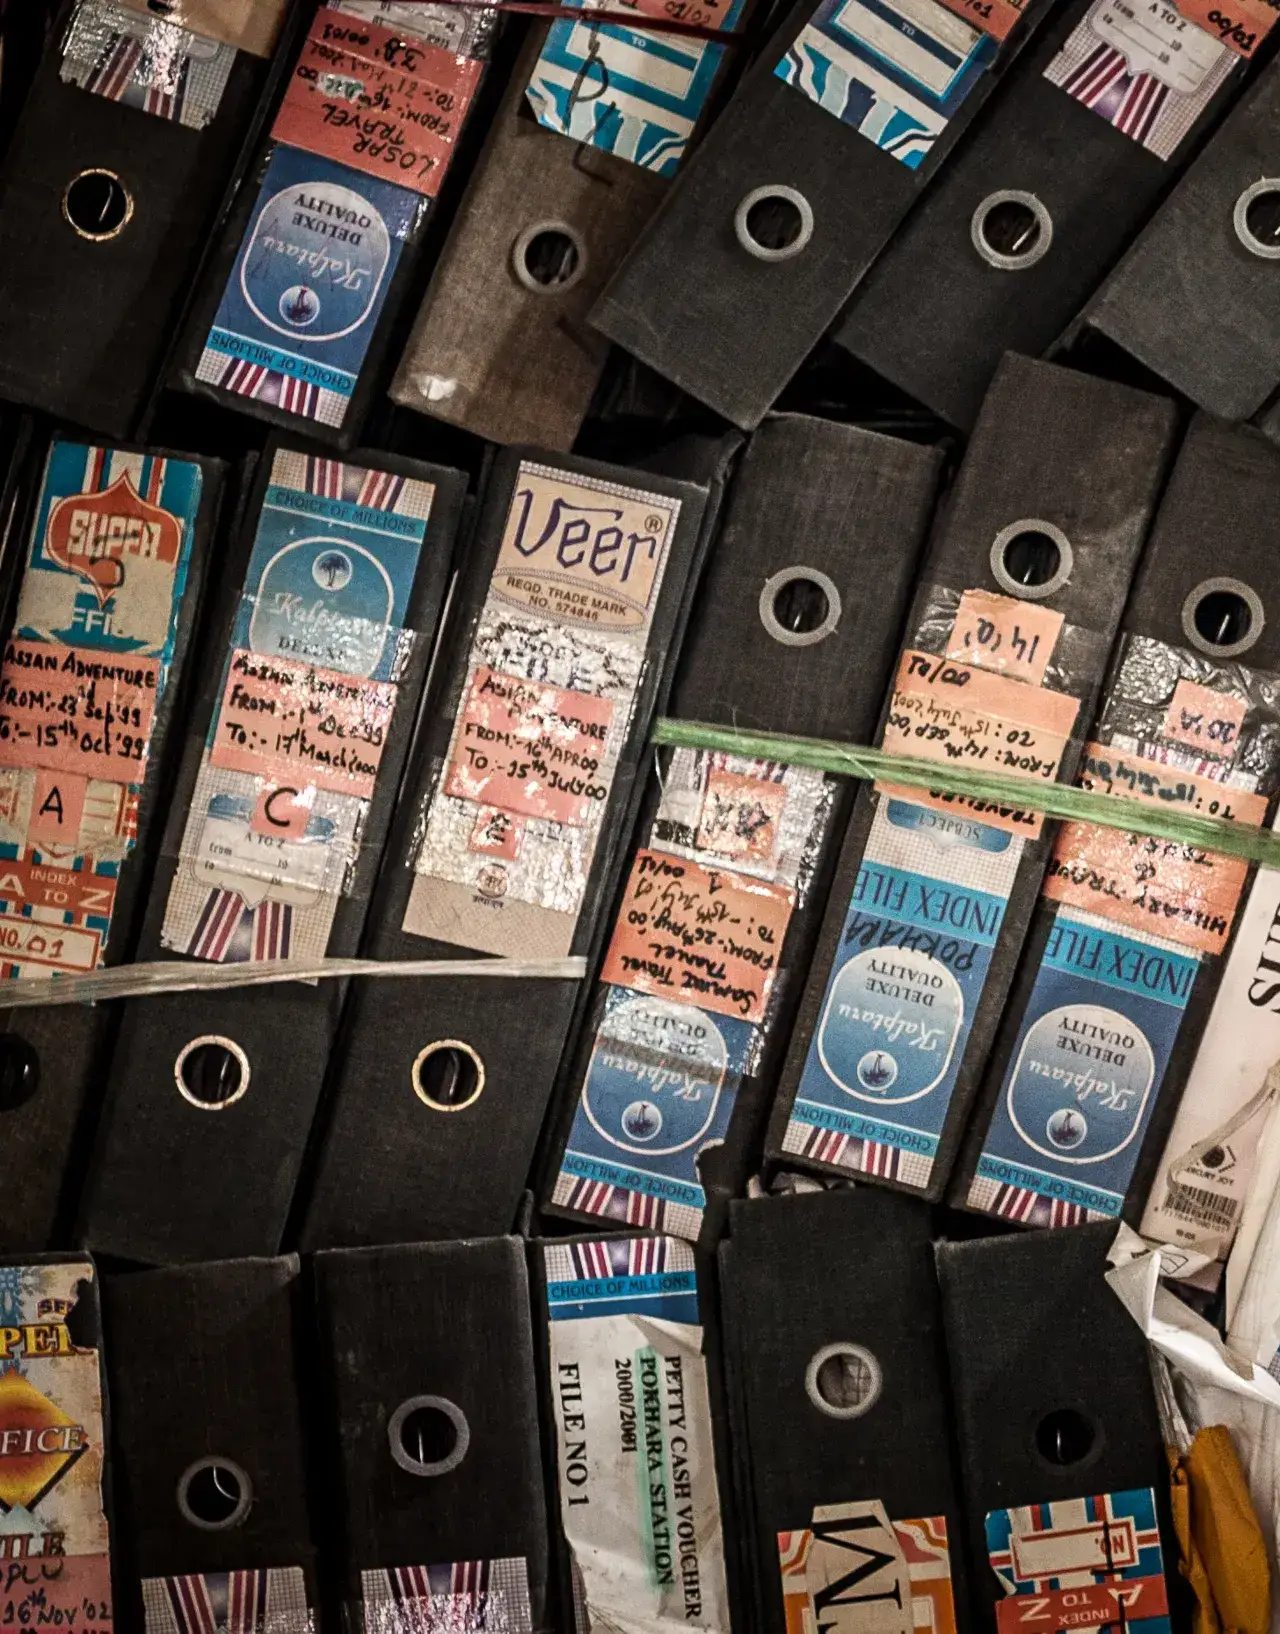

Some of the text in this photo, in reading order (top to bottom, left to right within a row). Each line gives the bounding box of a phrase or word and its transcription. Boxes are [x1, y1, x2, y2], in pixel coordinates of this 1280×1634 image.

[322, 103, 405, 146] TRAVEL
[291, 211, 362, 246] DELUXE
[293, 193, 372, 229] QUALITY
[263, 236, 372, 291] Kalptaru
[211, 332, 351, 390] CHOICE OF MILLIONS
[513, 487, 657, 584] Veer
[505, 576, 628, 616] REGD. TRADE MARK
[61, 651, 156, 689] ADVENTURE
[39, 785, 64, 824] A
[263, 787, 300, 828] C
[0, 873, 110, 912] A TO Z
[30, 869, 77, 888] INDEX
[852, 868, 1001, 938] INDEX FILE
[866, 958, 945, 990] QUALITY
[1045, 925, 1195, 1000] INDEX FILE
[865, 975, 937, 1009] DELUXE
[836, 1004, 949, 1052] Kalptaru
[1059, 1016, 1135, 1050] QUALITY
[1055, 1035, 1127, 1067] DELUXE
[1029, 1058, 1136, 1112] Kalptaru
[792, 1104, 932, 1152] CHOICE OF MILLIONS
[980, 1159, 1118, 1212] CHOICE OF MILLIONS
[550, 1275, 691, 1299] CHOICE OF MILLIONS
[614, 1357, 639, 1454] 2000/2001
[557, 1361, 591, 1509] FILE NO 1
[639, 1355, 675, 1586] POKHARA STATION
[663, 1355, 702, 1619] PETTY CASH VOUCHER
[3, 1531, 67, 1559] ILE
[1018, 1600, 1054, 1624] Z
[1057, 1609, 1111, 1627] INDEX
[1062, 1591, 1092, 1607] TO
